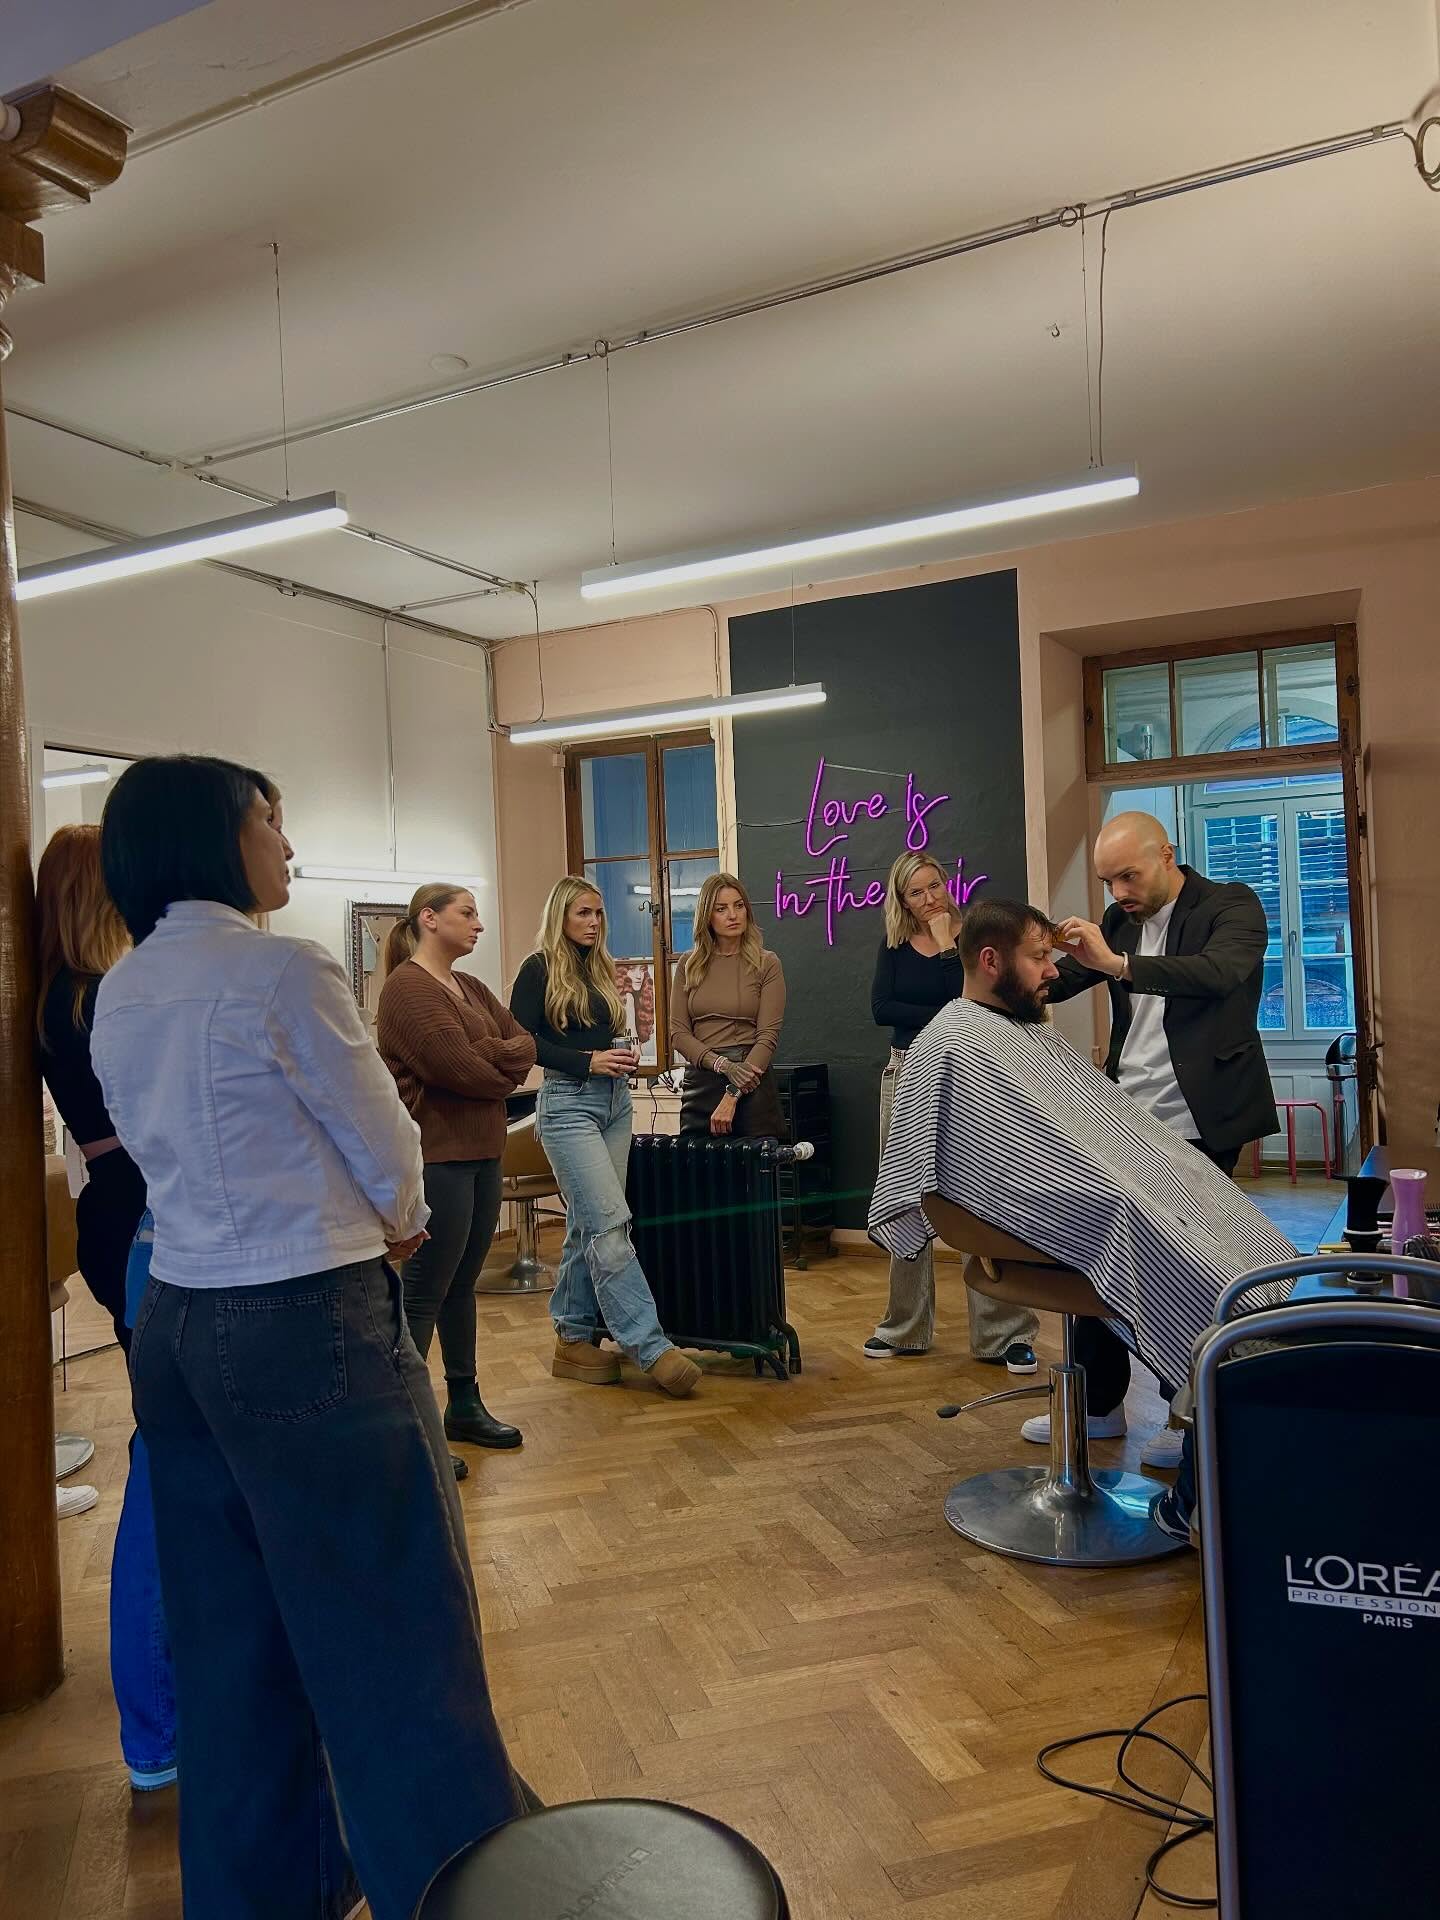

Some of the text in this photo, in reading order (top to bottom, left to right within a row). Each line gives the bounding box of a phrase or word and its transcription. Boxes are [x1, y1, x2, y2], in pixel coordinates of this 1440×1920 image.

[806, 755, 887, 856] Love
[775, 856, 988, 946] in the ir
[1291, 1589, 1437, 1615] PROFESSION
[1362, 1612, 1414, 1629] PARIS
